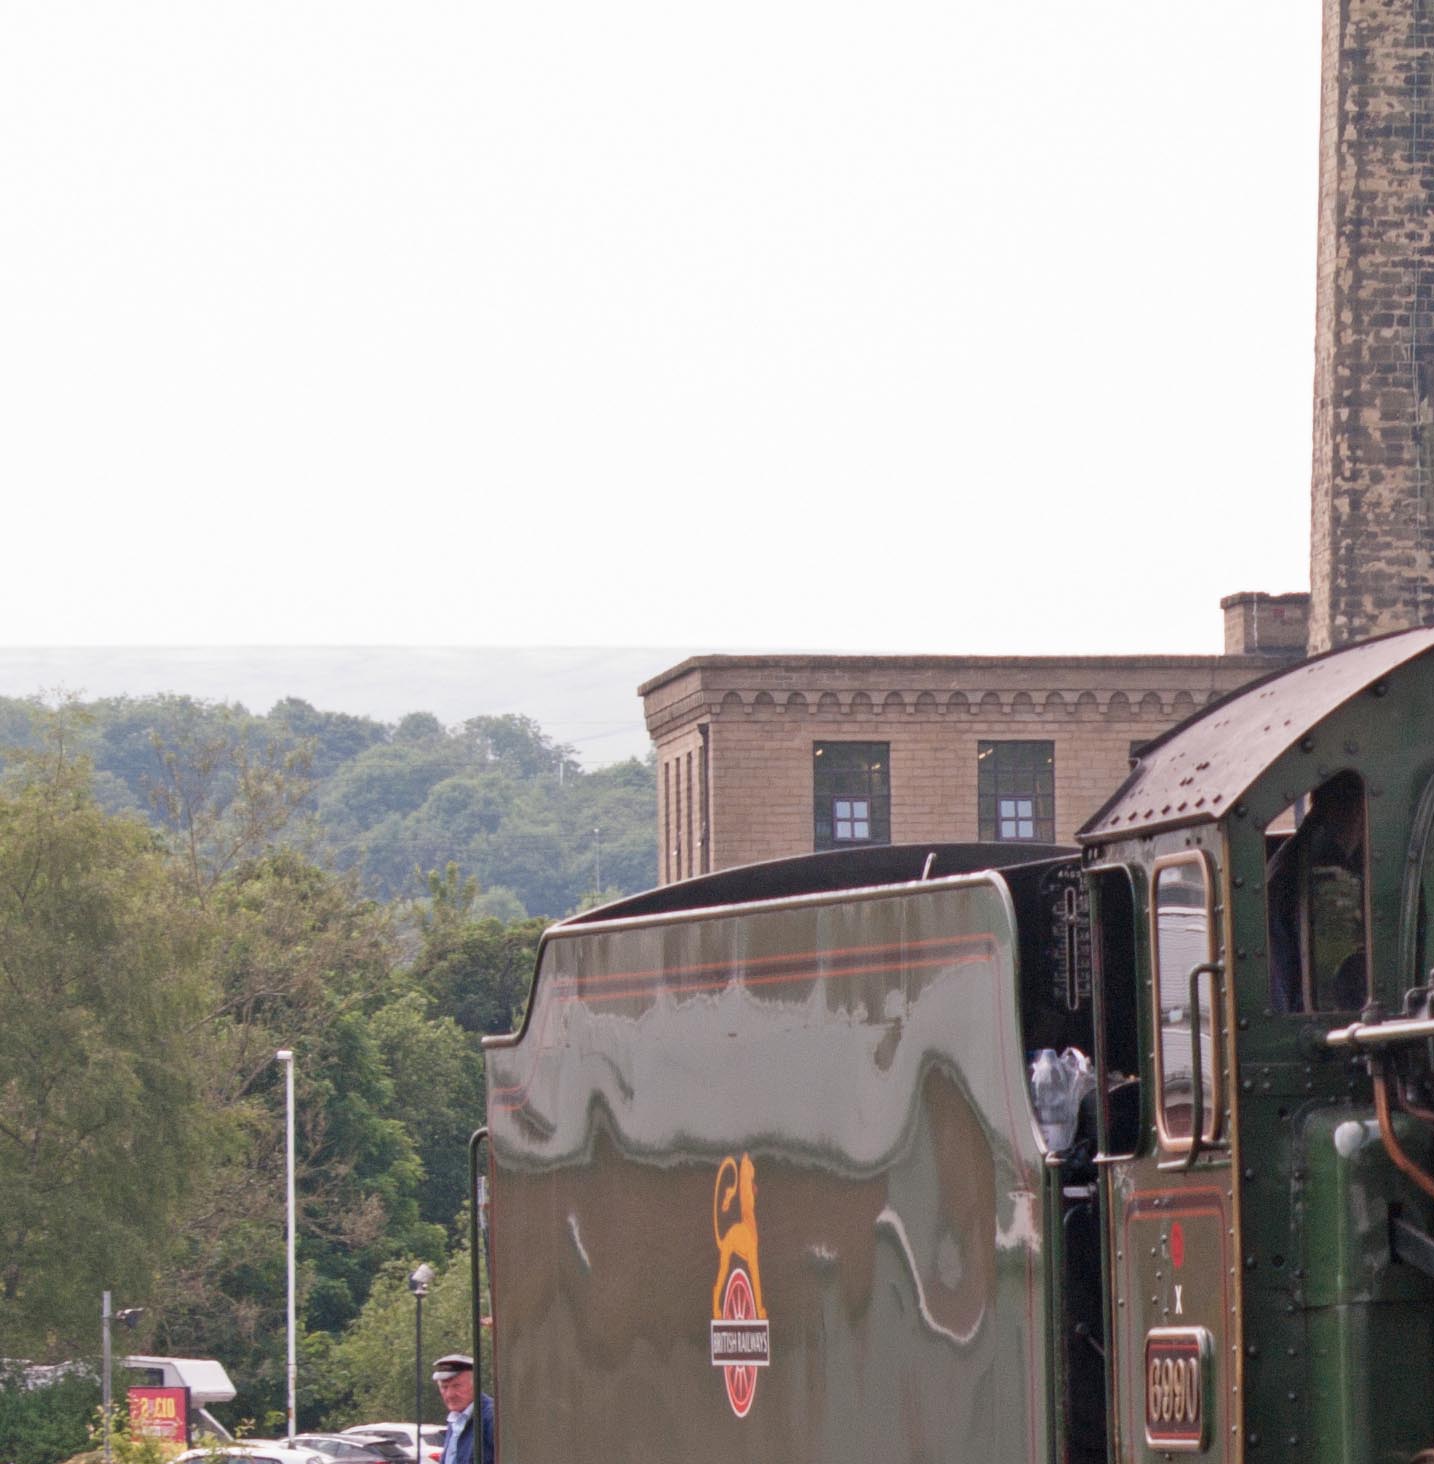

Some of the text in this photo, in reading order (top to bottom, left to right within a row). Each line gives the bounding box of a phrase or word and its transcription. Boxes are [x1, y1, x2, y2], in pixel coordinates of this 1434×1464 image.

[1174, 1284, 1183, 1315] X
[713, 1331, 767, 1353] BRITISH RAILWAYS
[1150, 1357, 1199, 1423] 6990
